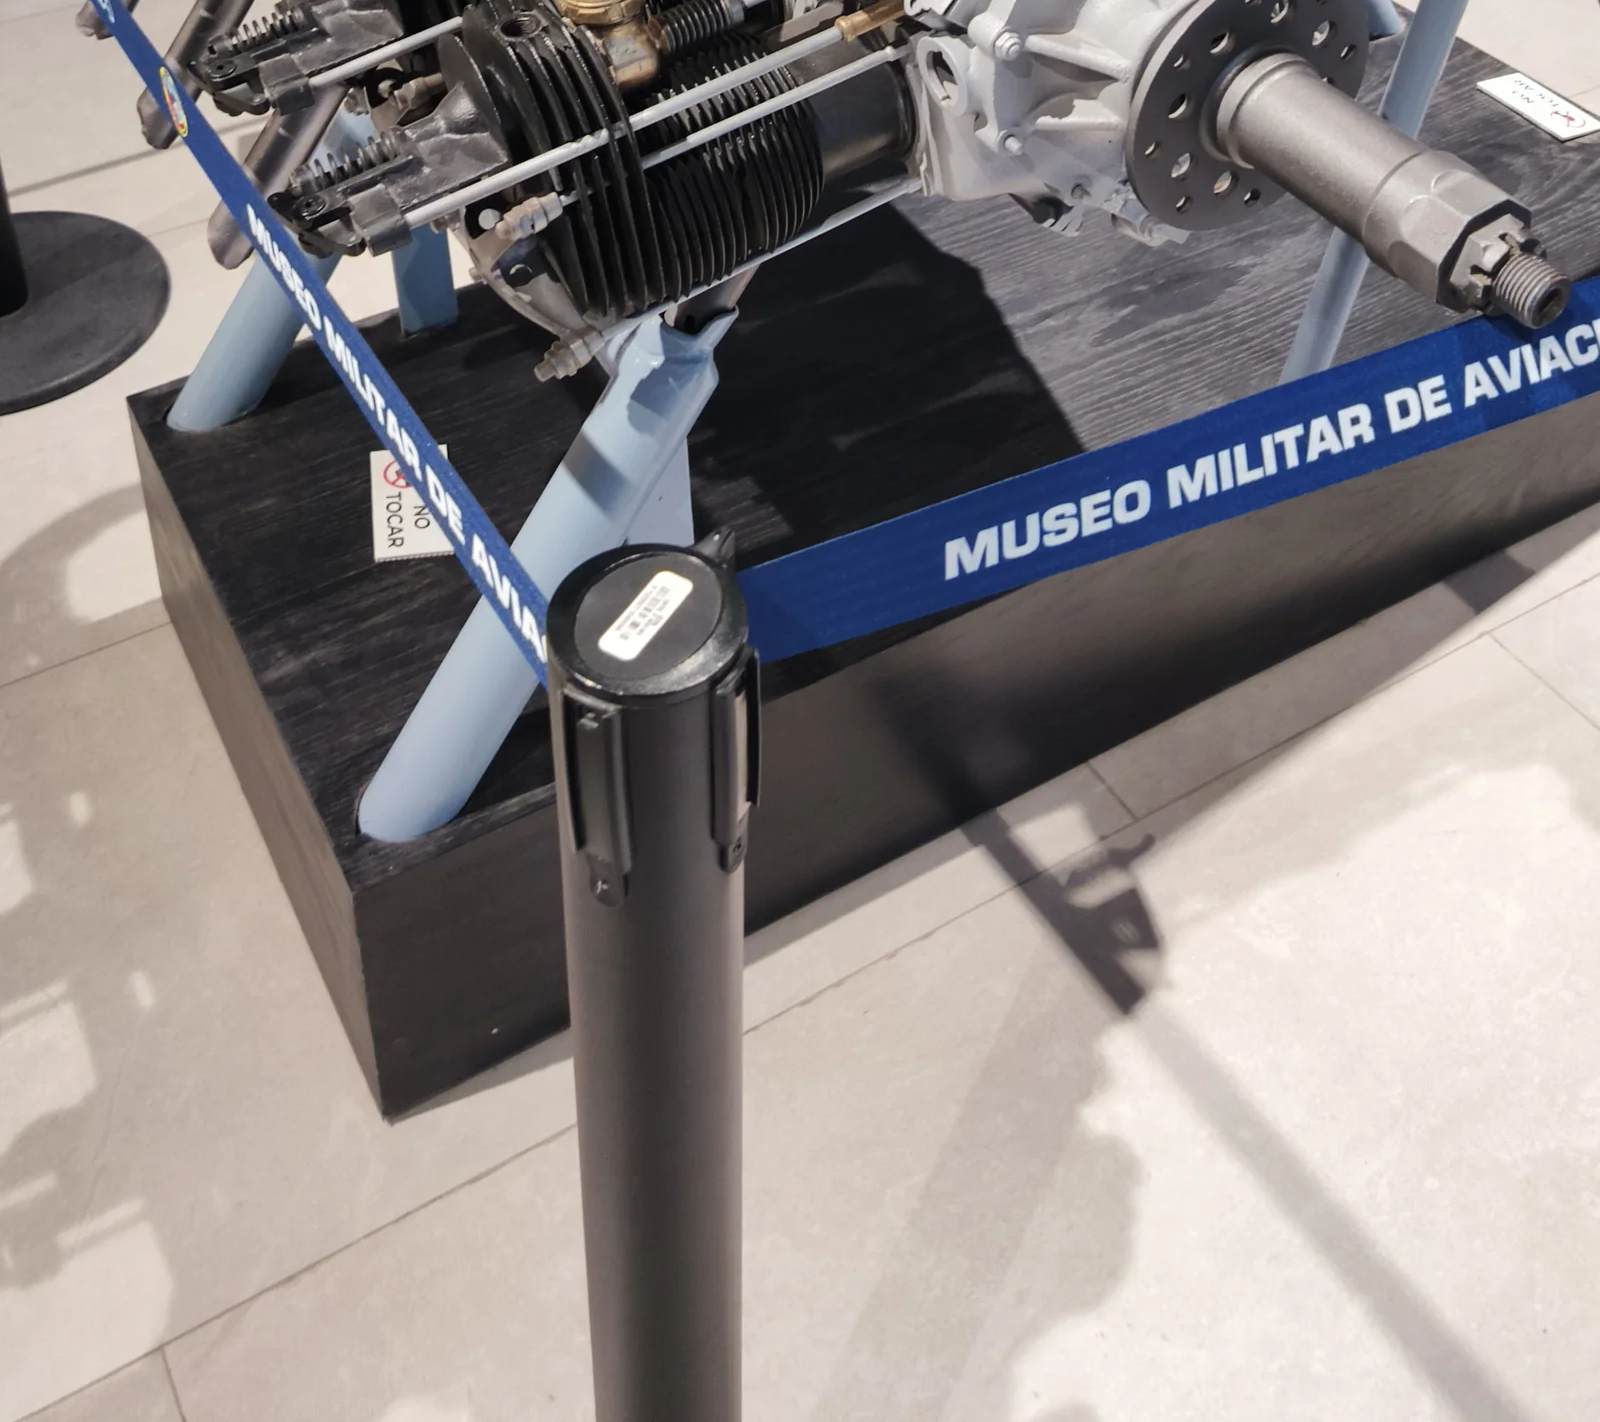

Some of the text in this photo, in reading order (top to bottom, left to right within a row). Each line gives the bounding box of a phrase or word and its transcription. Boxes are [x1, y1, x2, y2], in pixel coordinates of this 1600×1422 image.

[246, 204, 547, 663] MUSEO MILITAR DE AVIA
[944, 479, 1151, 581] MUSEO
[1166, 403, 1376, 509] MILITAR
[1384, 374, 1453, 434] DE
[386, 491, 404, 548] TOCAR
[413, 505, 430, 529] NO
